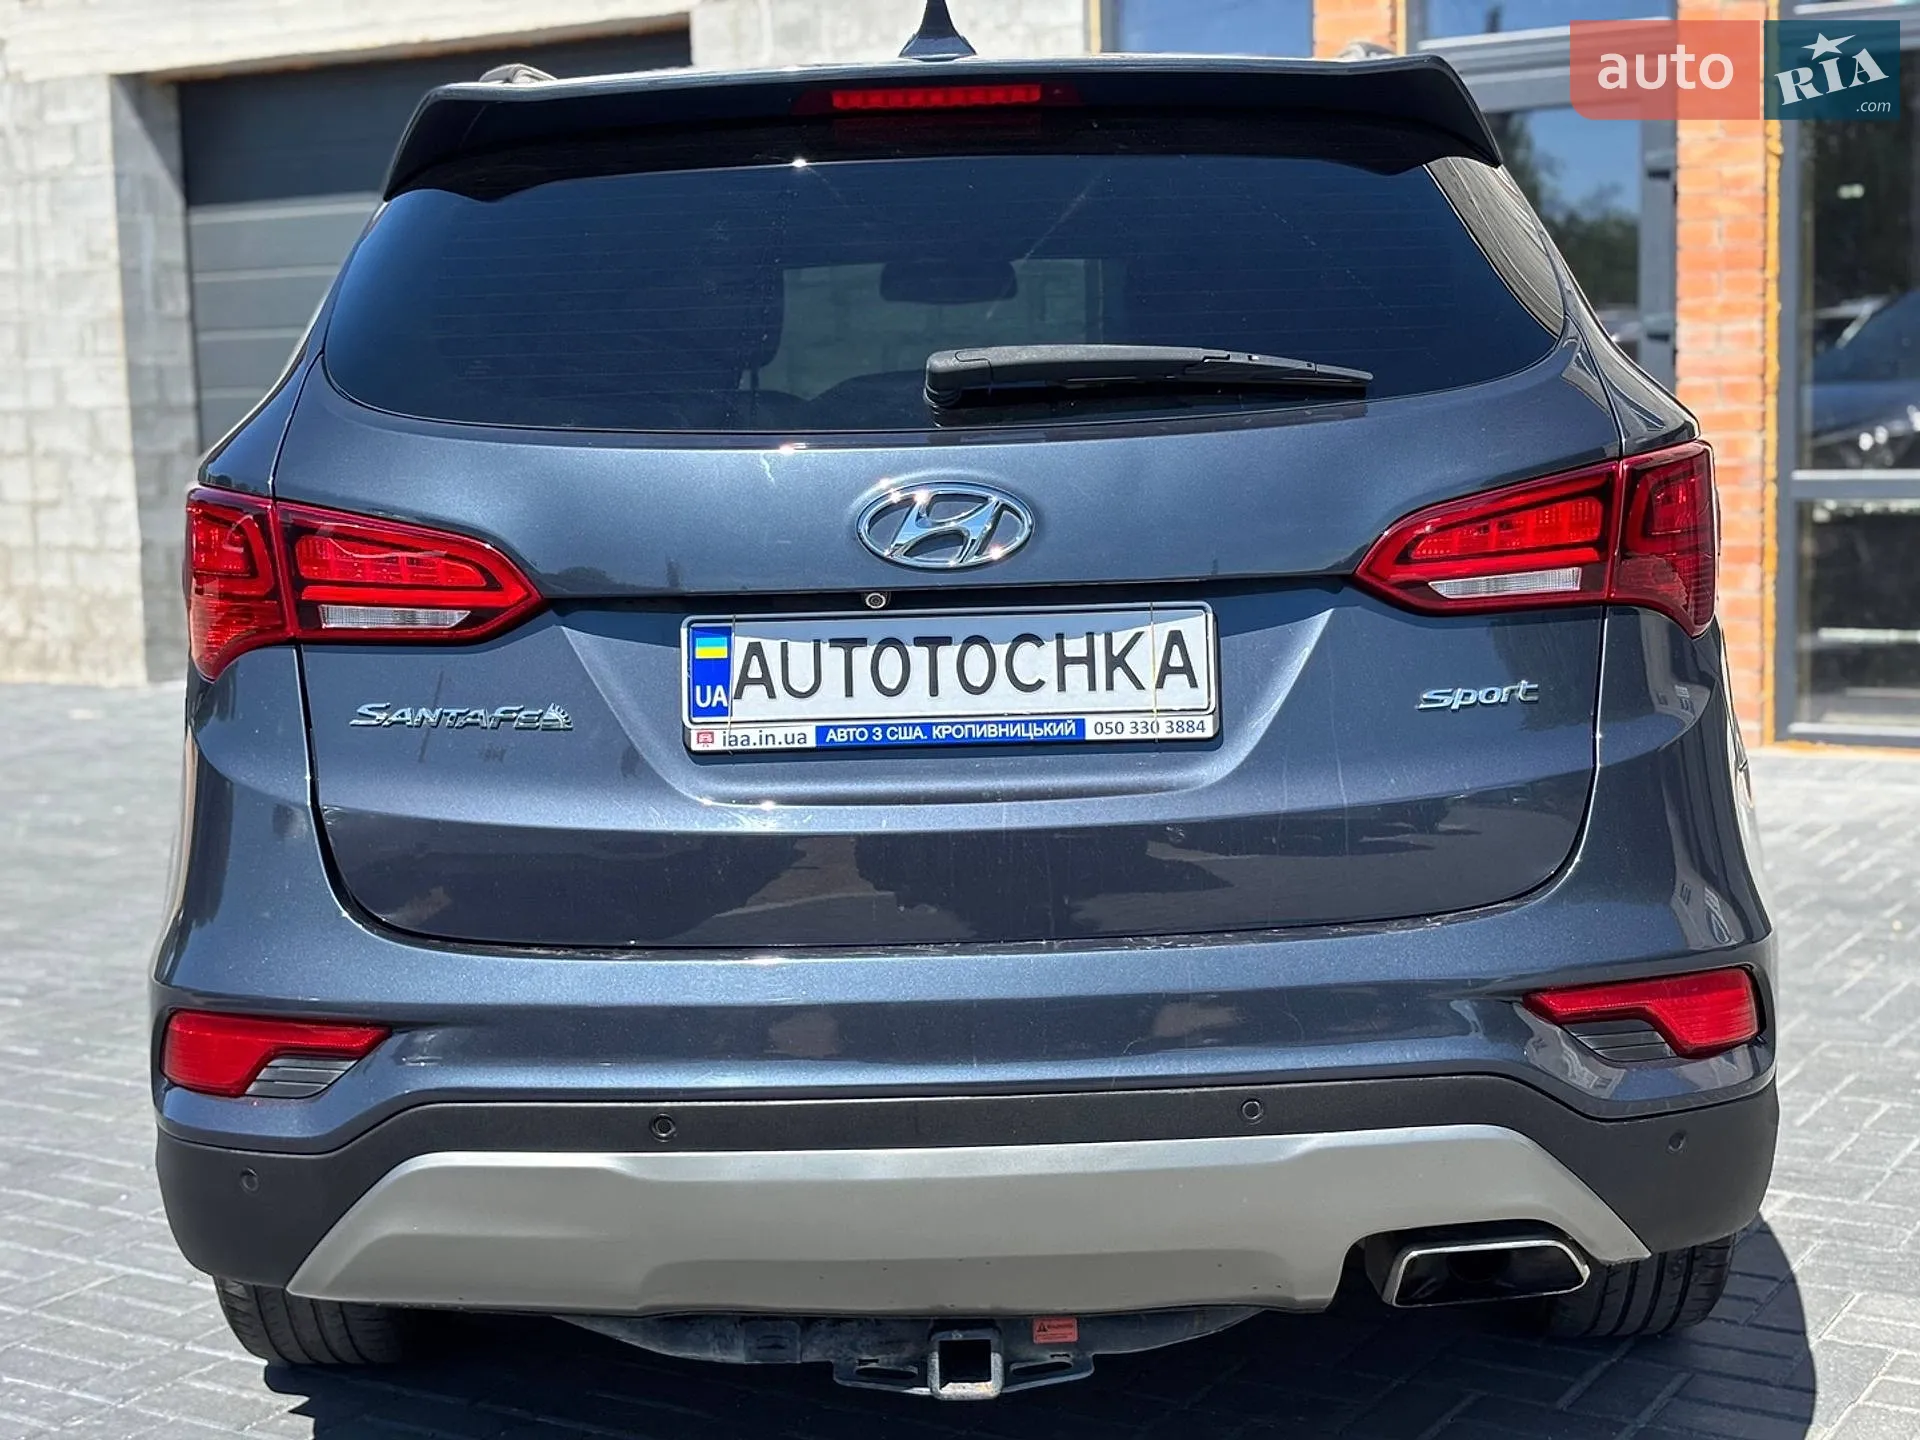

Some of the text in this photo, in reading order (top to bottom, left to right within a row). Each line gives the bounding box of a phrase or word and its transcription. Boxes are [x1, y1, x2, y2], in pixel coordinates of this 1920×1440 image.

[733, 629, 1199, 700] AUTOTOCHKA
[695, 685, 728, 708] UA
[1415, 679, 1539, 711] Sport
[722, 730, 807, 747] iaa.in.ua
[825, 727, 867, 743] АВТО
[886, 725, 928, 742] США.
[932, 719, 1076, 741] КРОПИВНИЦЬКИЙ
[1093, 719, 1207, 735] 050 330 3884
